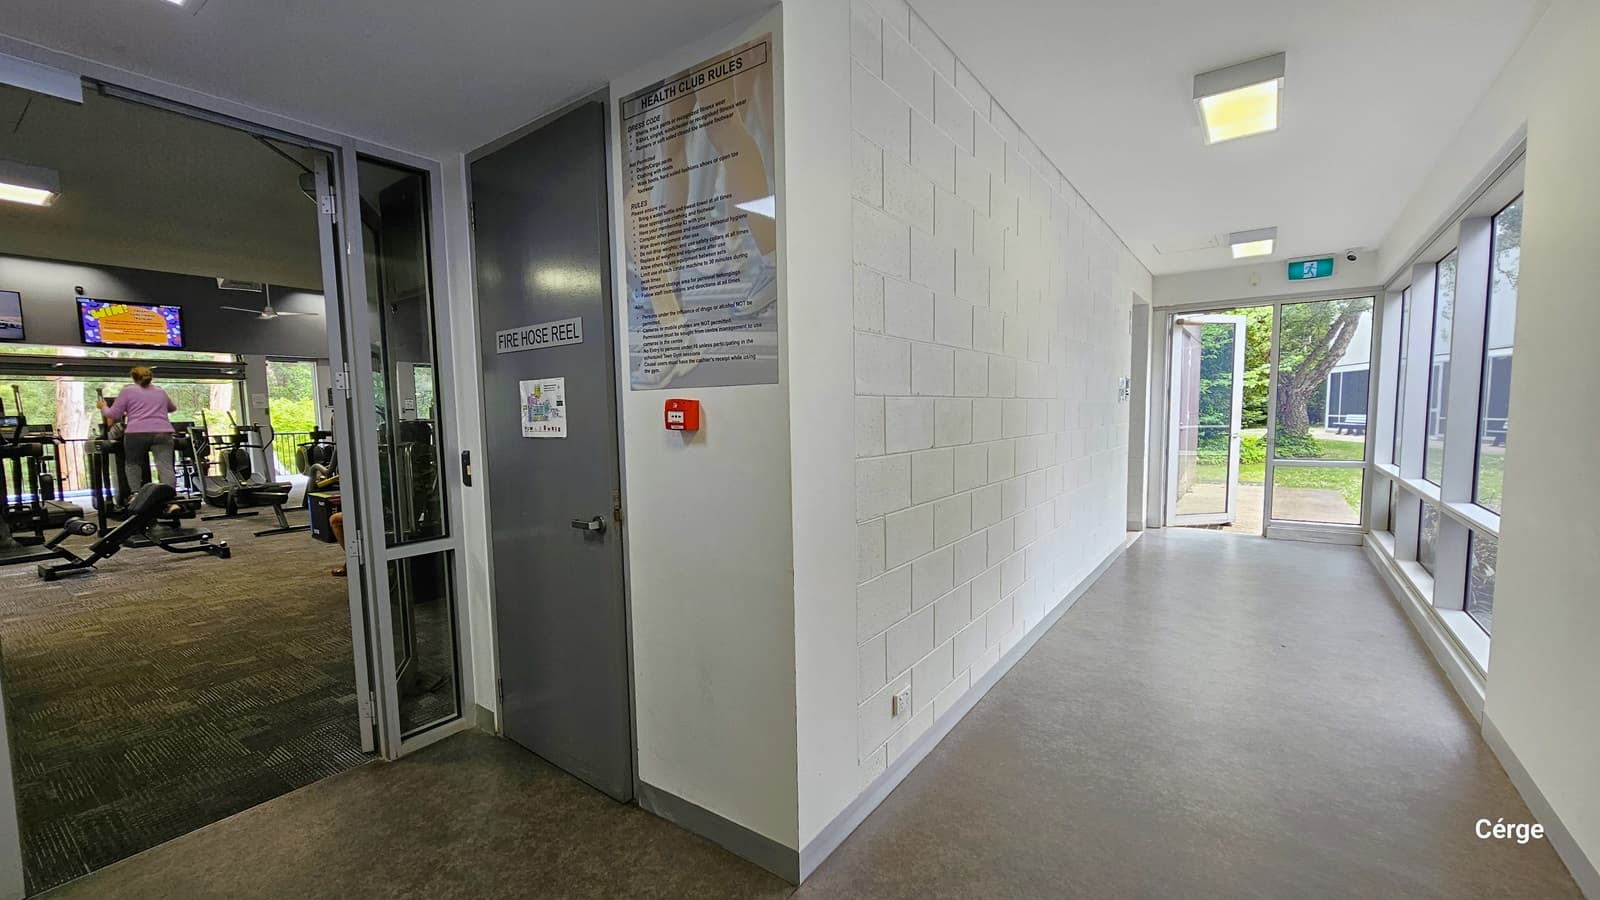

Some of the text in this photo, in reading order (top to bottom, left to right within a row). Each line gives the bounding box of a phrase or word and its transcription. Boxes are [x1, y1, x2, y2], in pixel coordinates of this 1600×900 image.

[641, 57, 743, 109] HEALTH CLUB RULES
[628, 115, 661, 133] DRESS CODE
[631, 200, 648, 210] RULES
[498, 323, 580, 349] FIRE HOSE REEL
